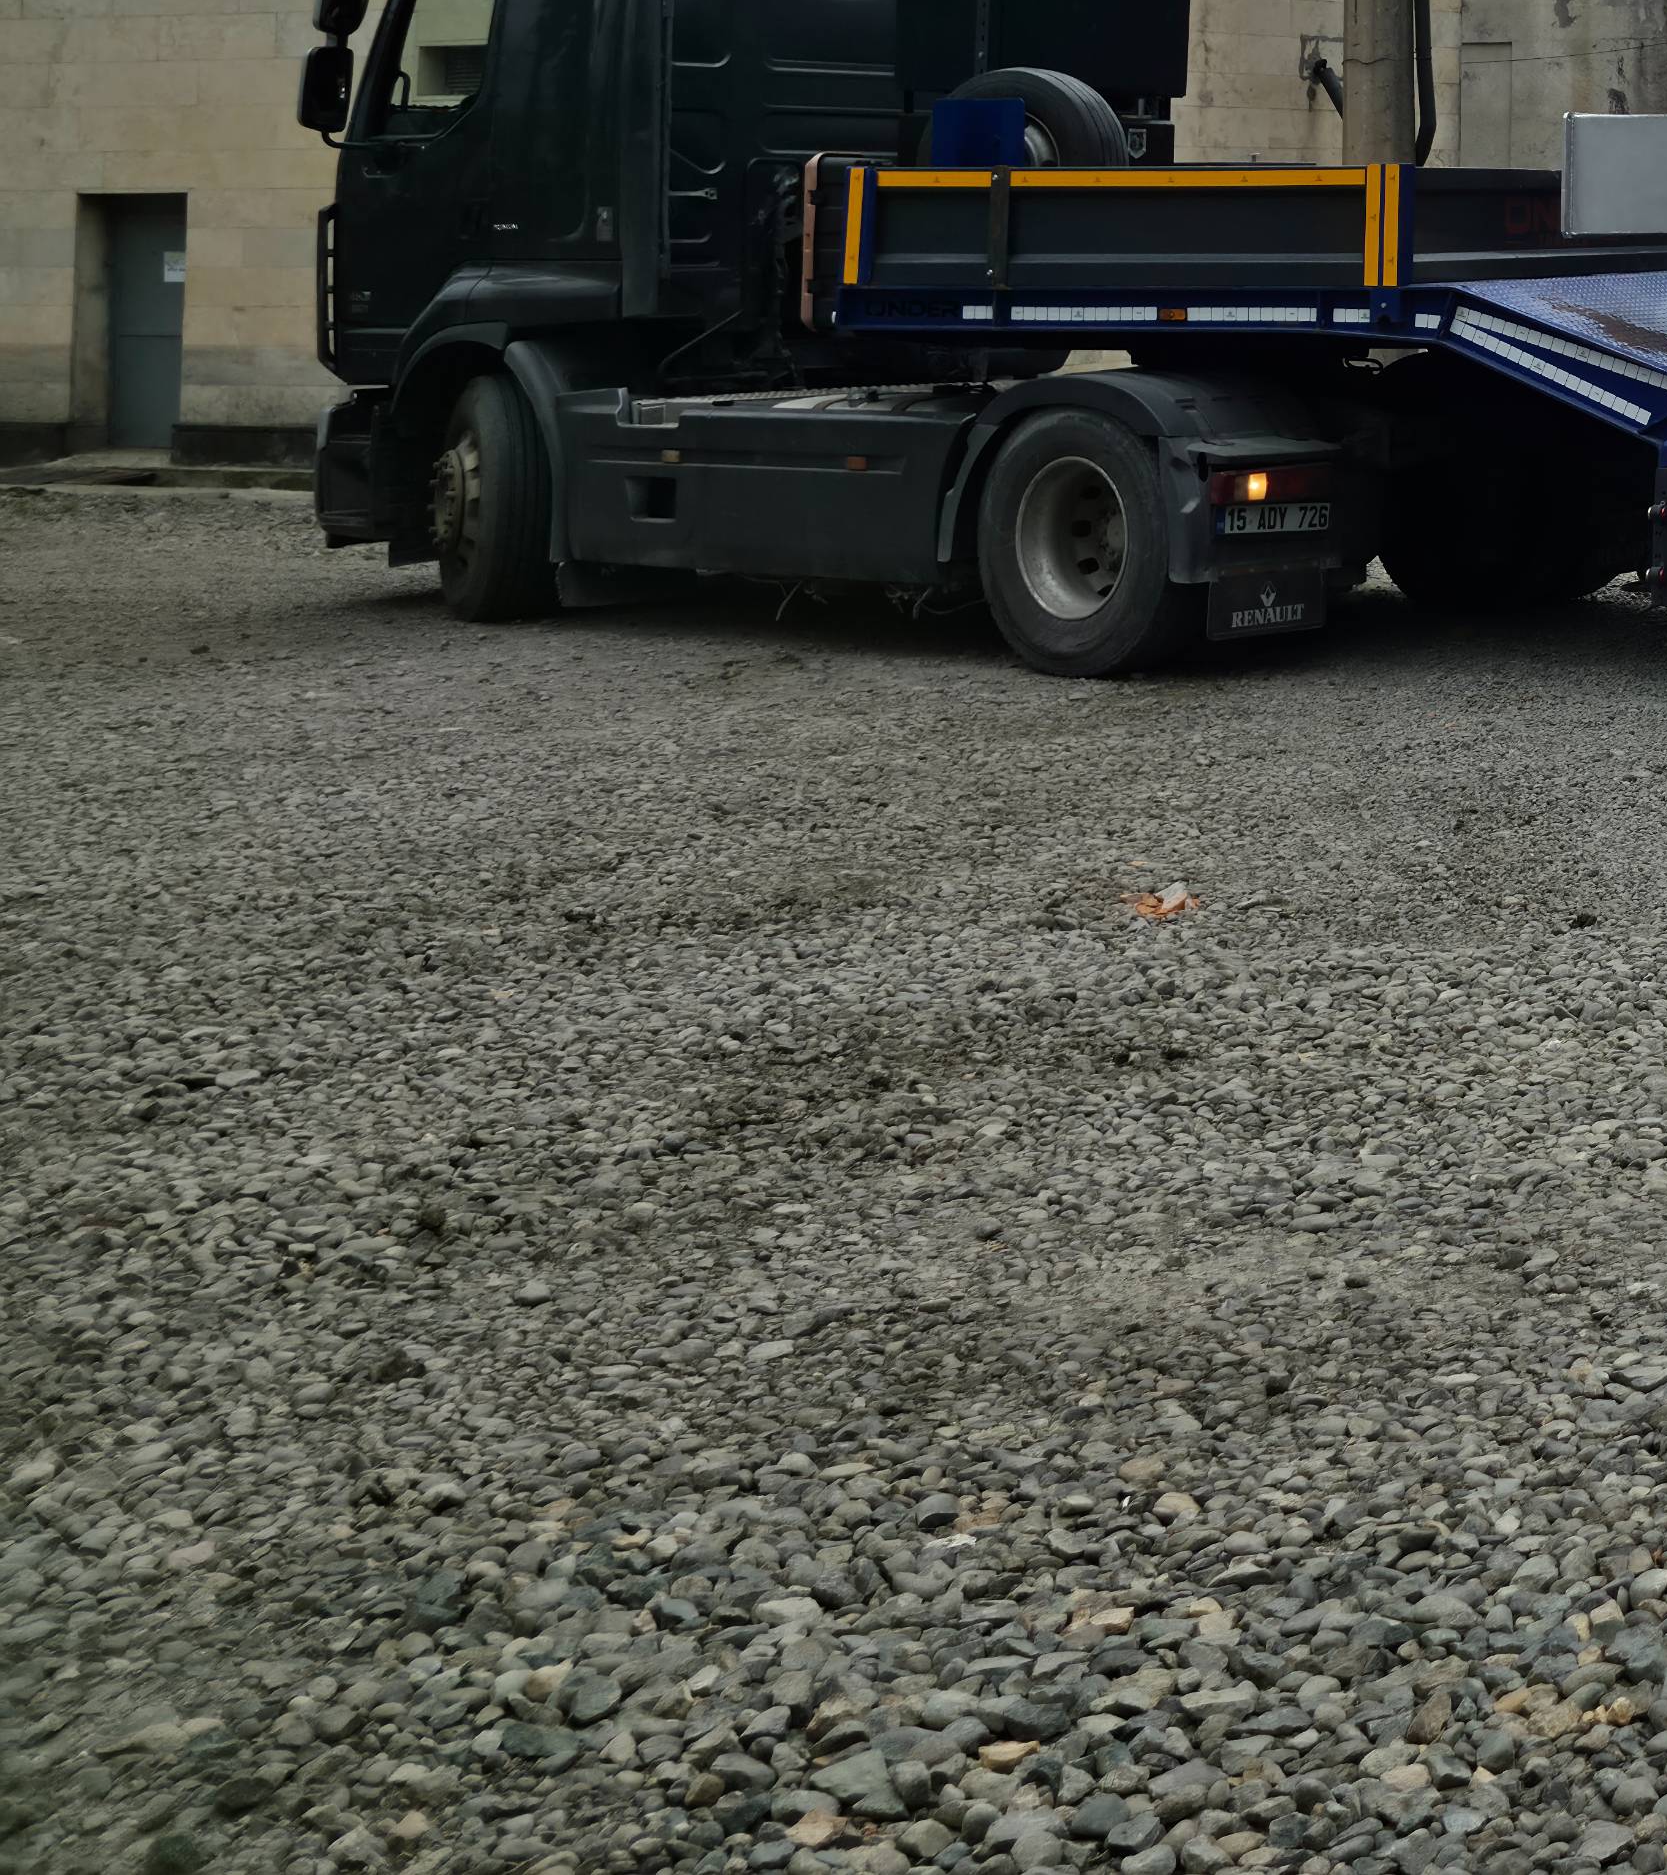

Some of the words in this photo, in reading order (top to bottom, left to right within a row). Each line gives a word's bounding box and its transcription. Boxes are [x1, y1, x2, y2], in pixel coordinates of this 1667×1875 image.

[1228, 508, 1247, 531] 15
[1257, 507, 1288, 530] ADY
[1298, 505, 1328, 528] 726
[1232, 603, 1303, 628] RENAULT
